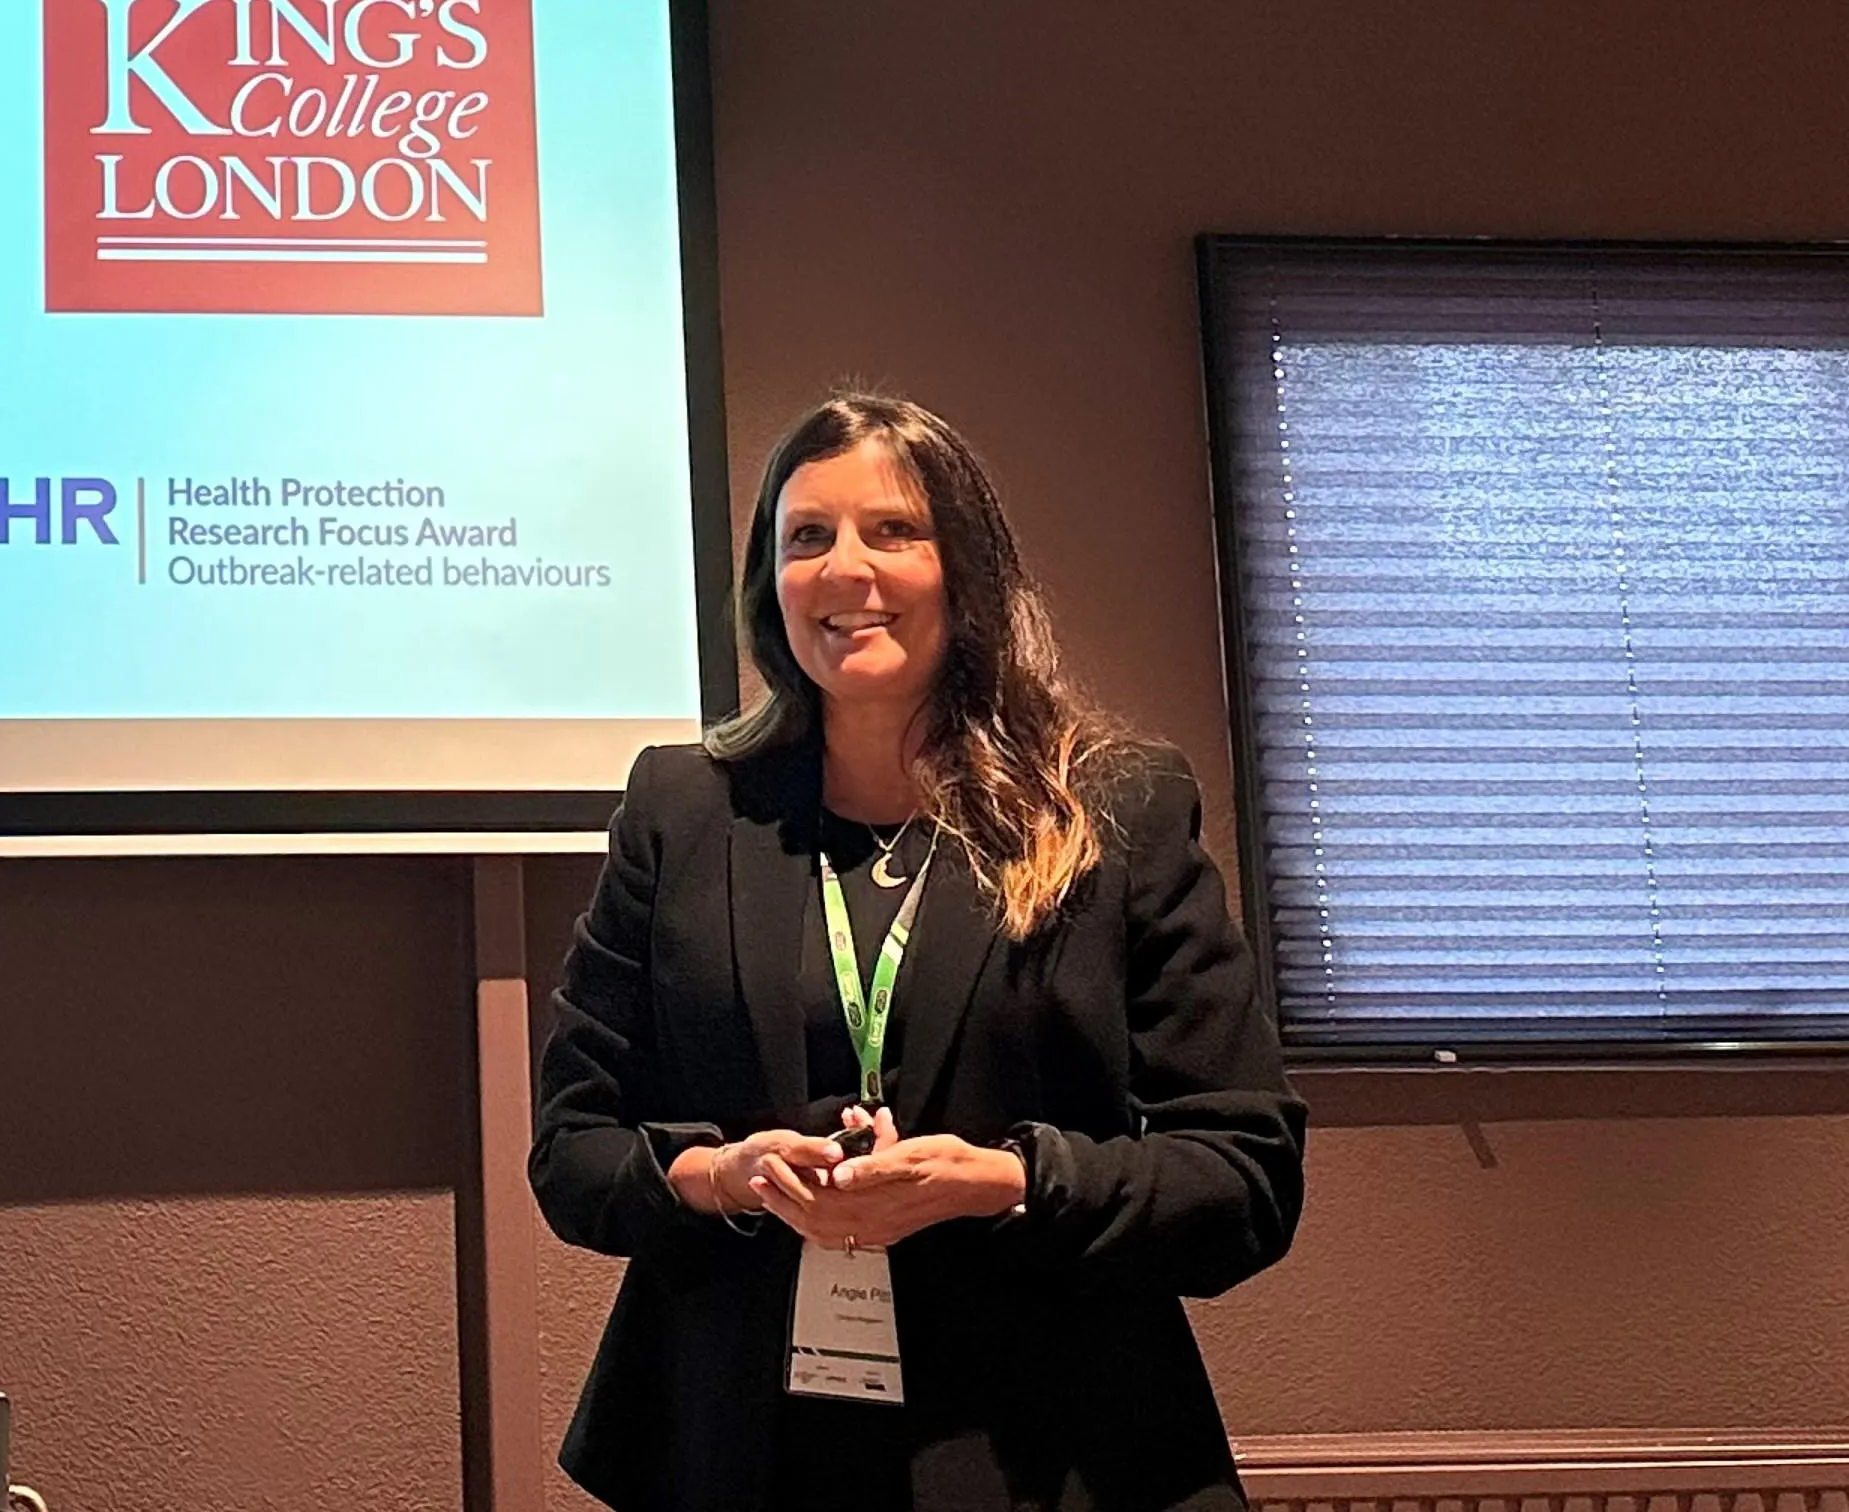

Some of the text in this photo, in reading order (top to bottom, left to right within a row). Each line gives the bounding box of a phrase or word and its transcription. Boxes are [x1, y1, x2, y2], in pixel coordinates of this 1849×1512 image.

[229, 71, 489, 159] College
[94, 153, 493, 223] LONDON
[168, 477, 444, 507] Health Protection
[169, 517, 517, 546] Research Focus Award
[168, 556, 611, 587] Outbreak-related behaviours
